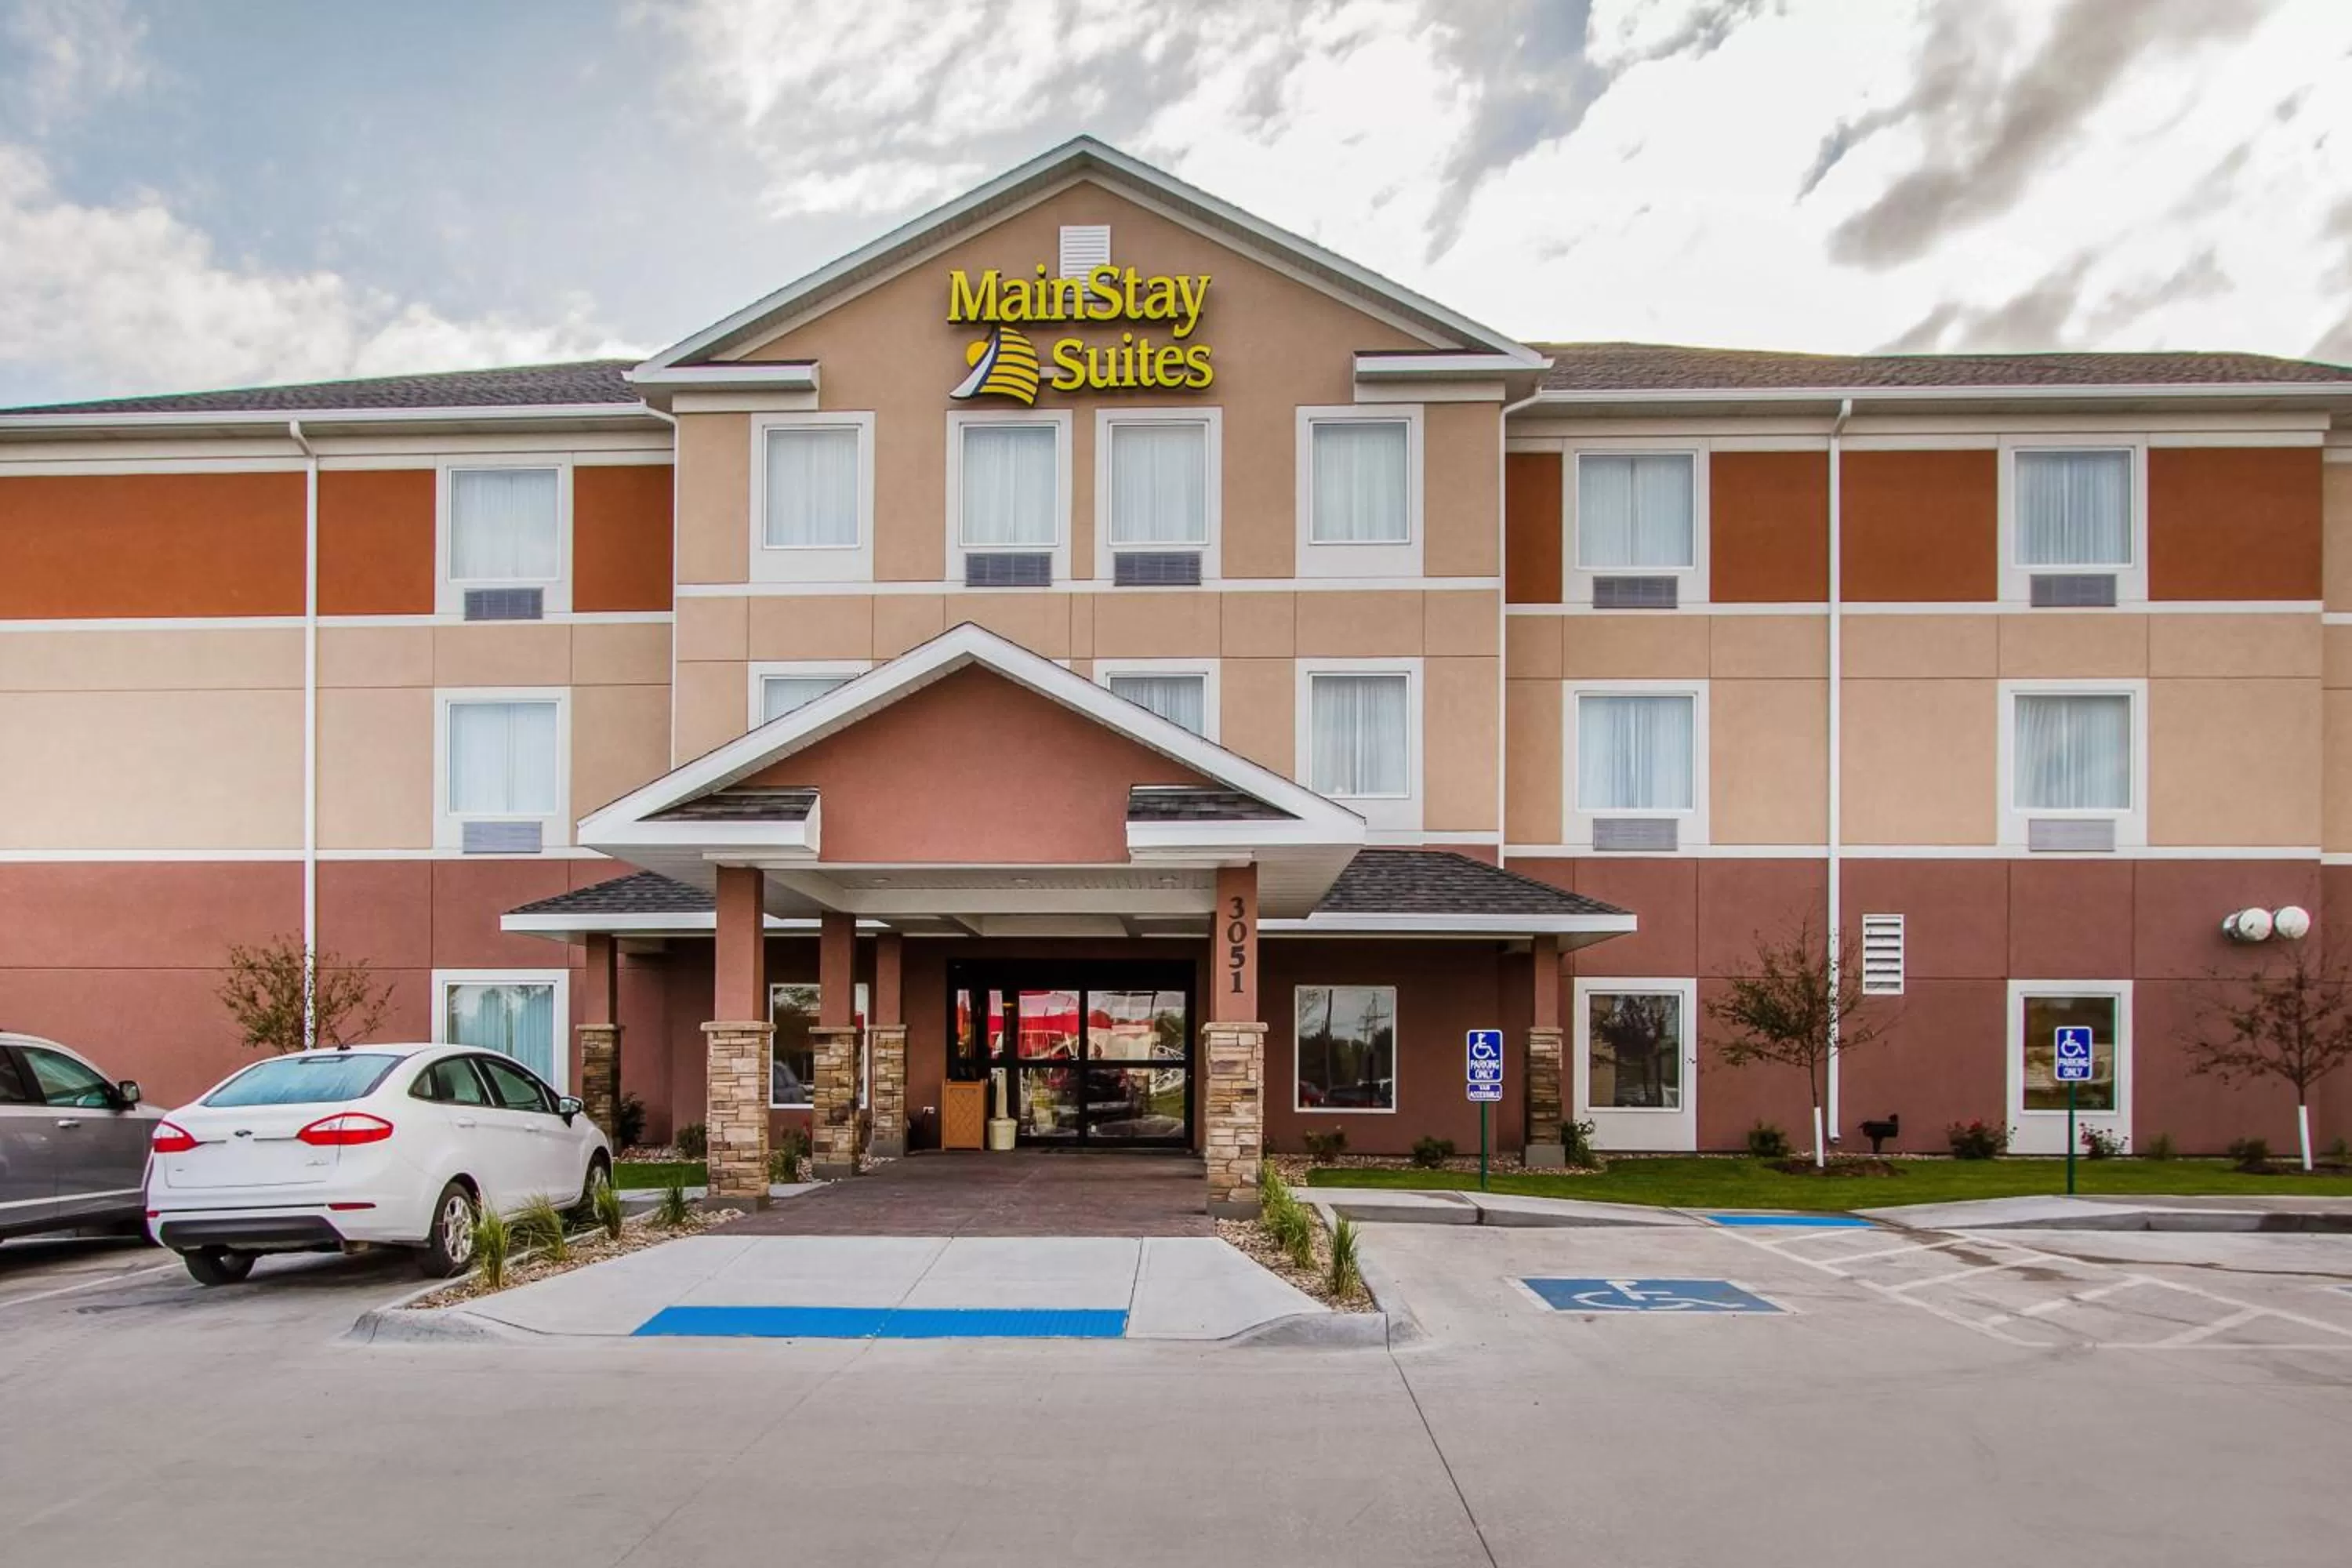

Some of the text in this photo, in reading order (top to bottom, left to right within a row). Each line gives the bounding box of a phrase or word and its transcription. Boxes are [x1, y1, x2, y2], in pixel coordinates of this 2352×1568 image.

[946, 263, 1212, 339] MainStay
[1051, 332, 1214, 391] Suites
[1227, 896, 1247, 993] 3051
[1470, 1059, 1500, 1069] PARKING
[2059, 1058, 2089, 1067] PARKING
[1475, 1069, 1494, 1079] ONLY
[2063, 1067, 2083, 1076] ONLY
